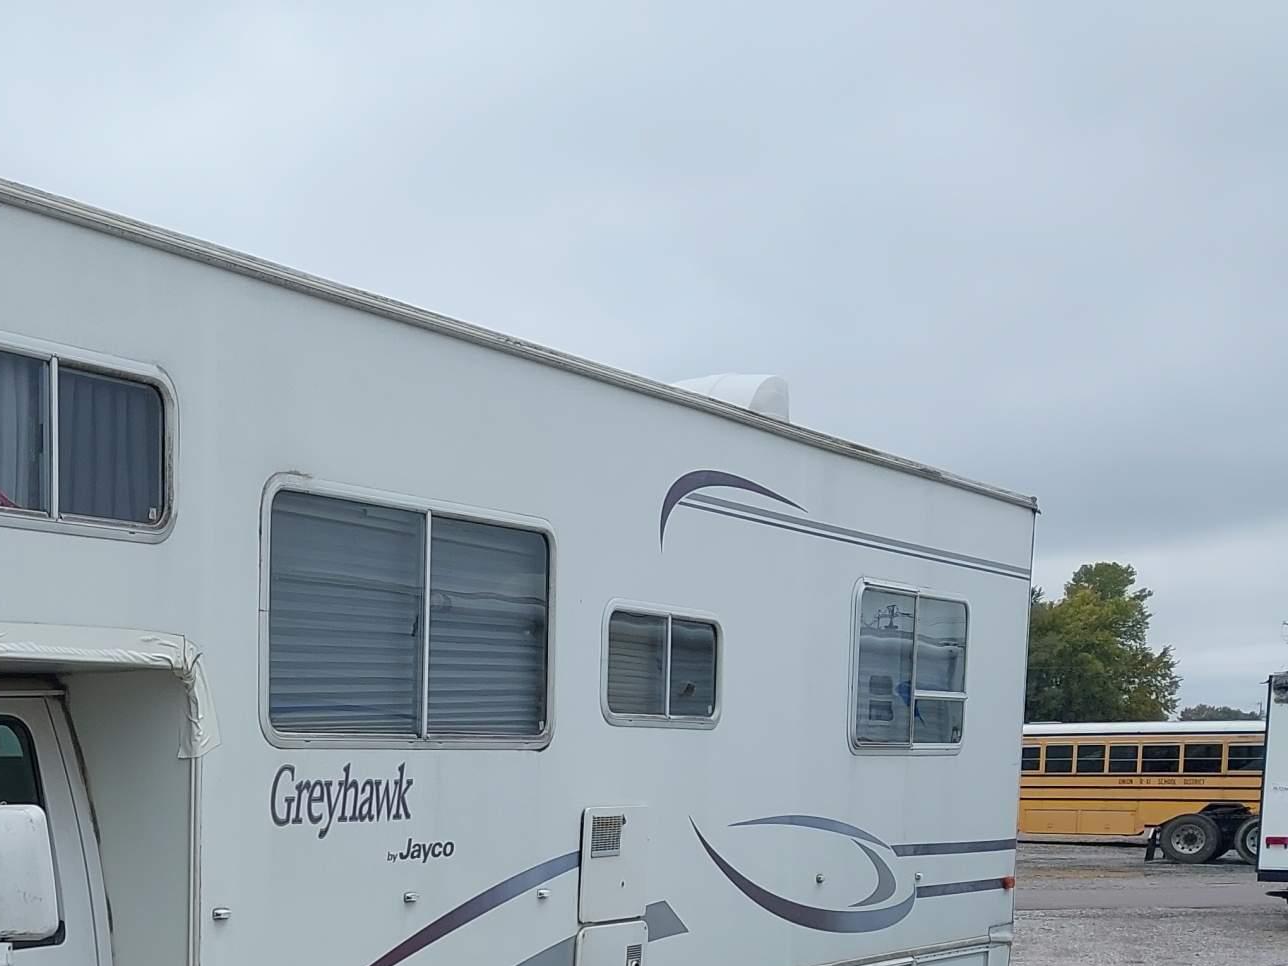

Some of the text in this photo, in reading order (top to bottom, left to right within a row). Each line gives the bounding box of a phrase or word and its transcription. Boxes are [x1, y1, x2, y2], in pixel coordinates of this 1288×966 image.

[270, 762, 414, 839] Greyhawk
[387, 838, 455, 863] by Jayco
